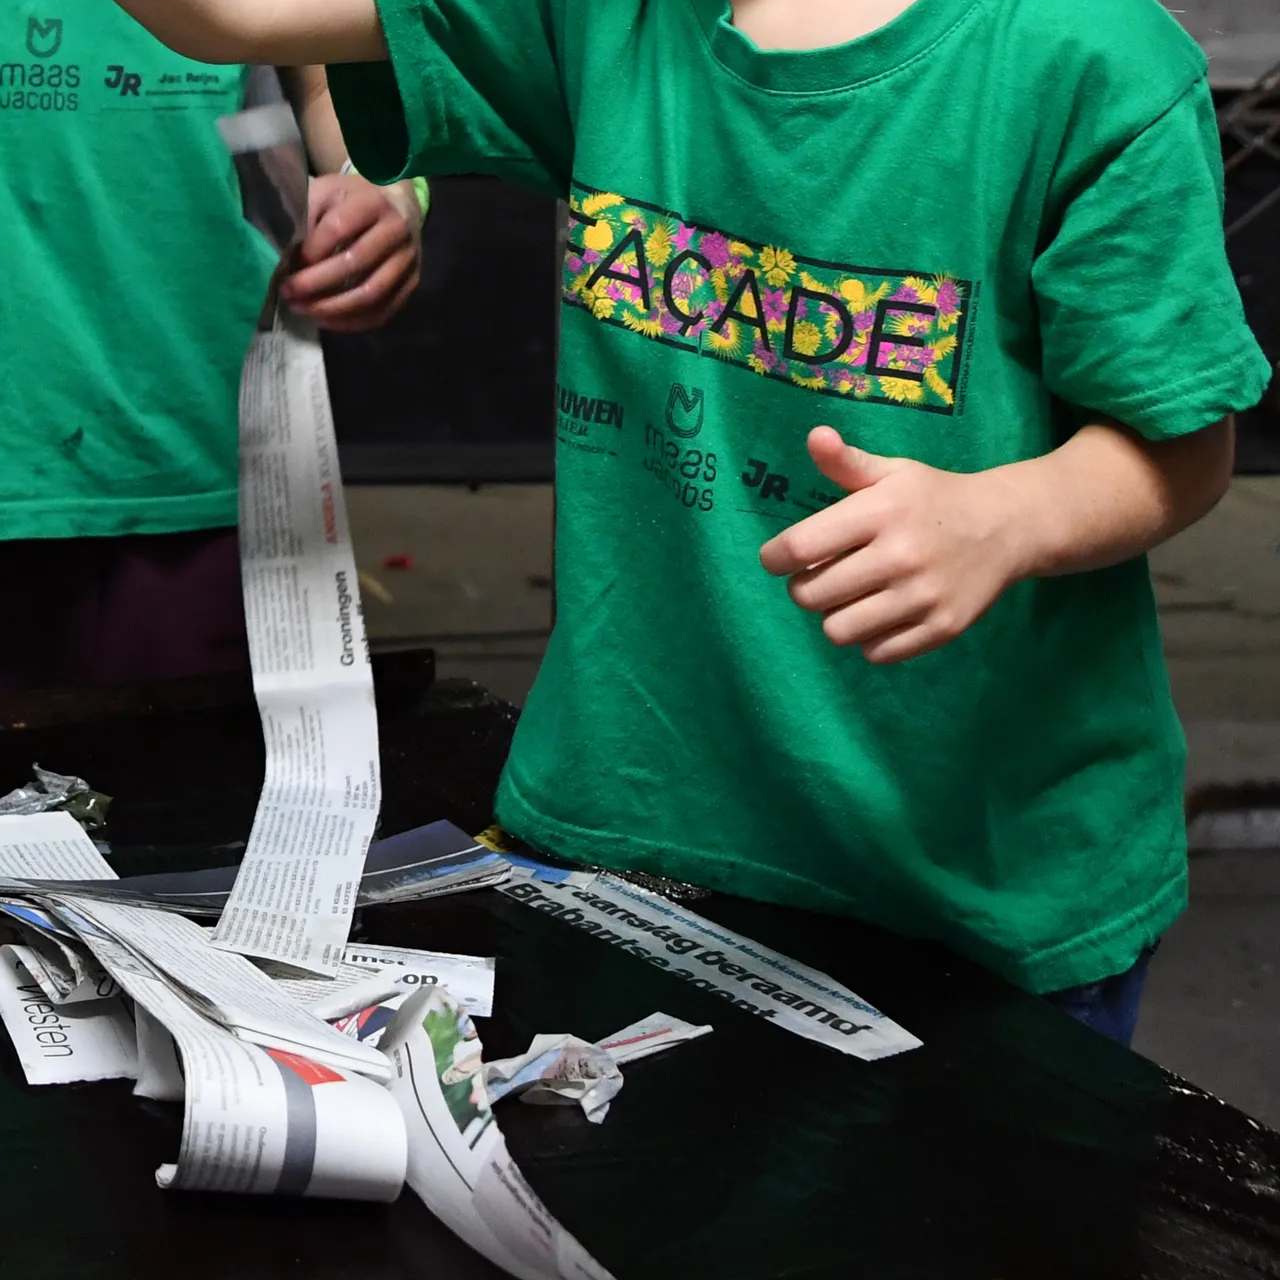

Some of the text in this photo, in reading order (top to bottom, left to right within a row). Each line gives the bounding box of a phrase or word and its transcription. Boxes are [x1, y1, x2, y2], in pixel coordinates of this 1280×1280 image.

[103, 64, 143, 97] JR
[741, 457, 790, 503] JR
[335, 571, 355, 667] Groningen
[580, 888, 875, 1036] aanslag beraamd
[15, 982, 74, 1058] Westen
